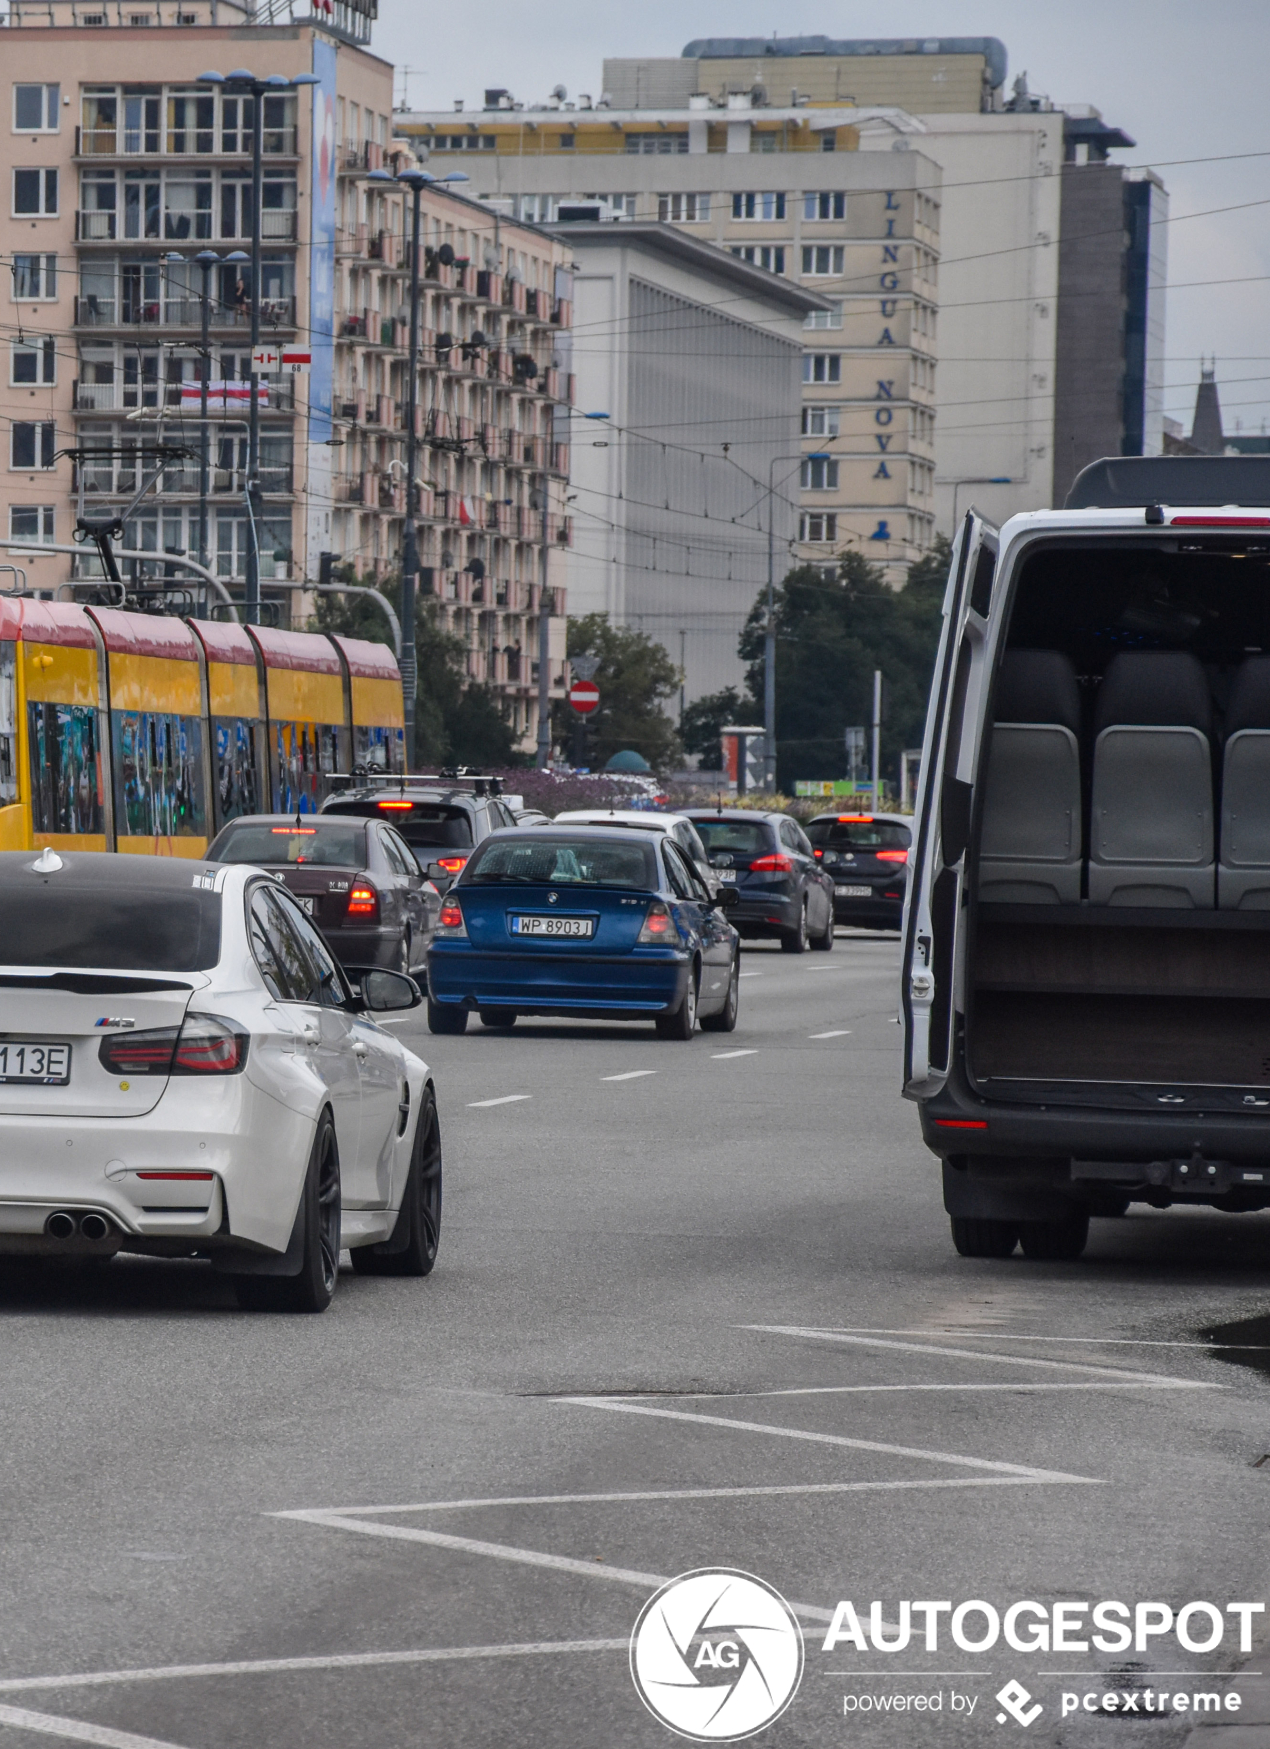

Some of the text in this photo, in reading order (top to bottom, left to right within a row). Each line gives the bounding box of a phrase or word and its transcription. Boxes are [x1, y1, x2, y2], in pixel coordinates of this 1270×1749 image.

[873, 191, 900, 480] LINGUA NOVA
[291, 363, 302, 373] 68
[521, 919, 590, 936] WP 8903J
